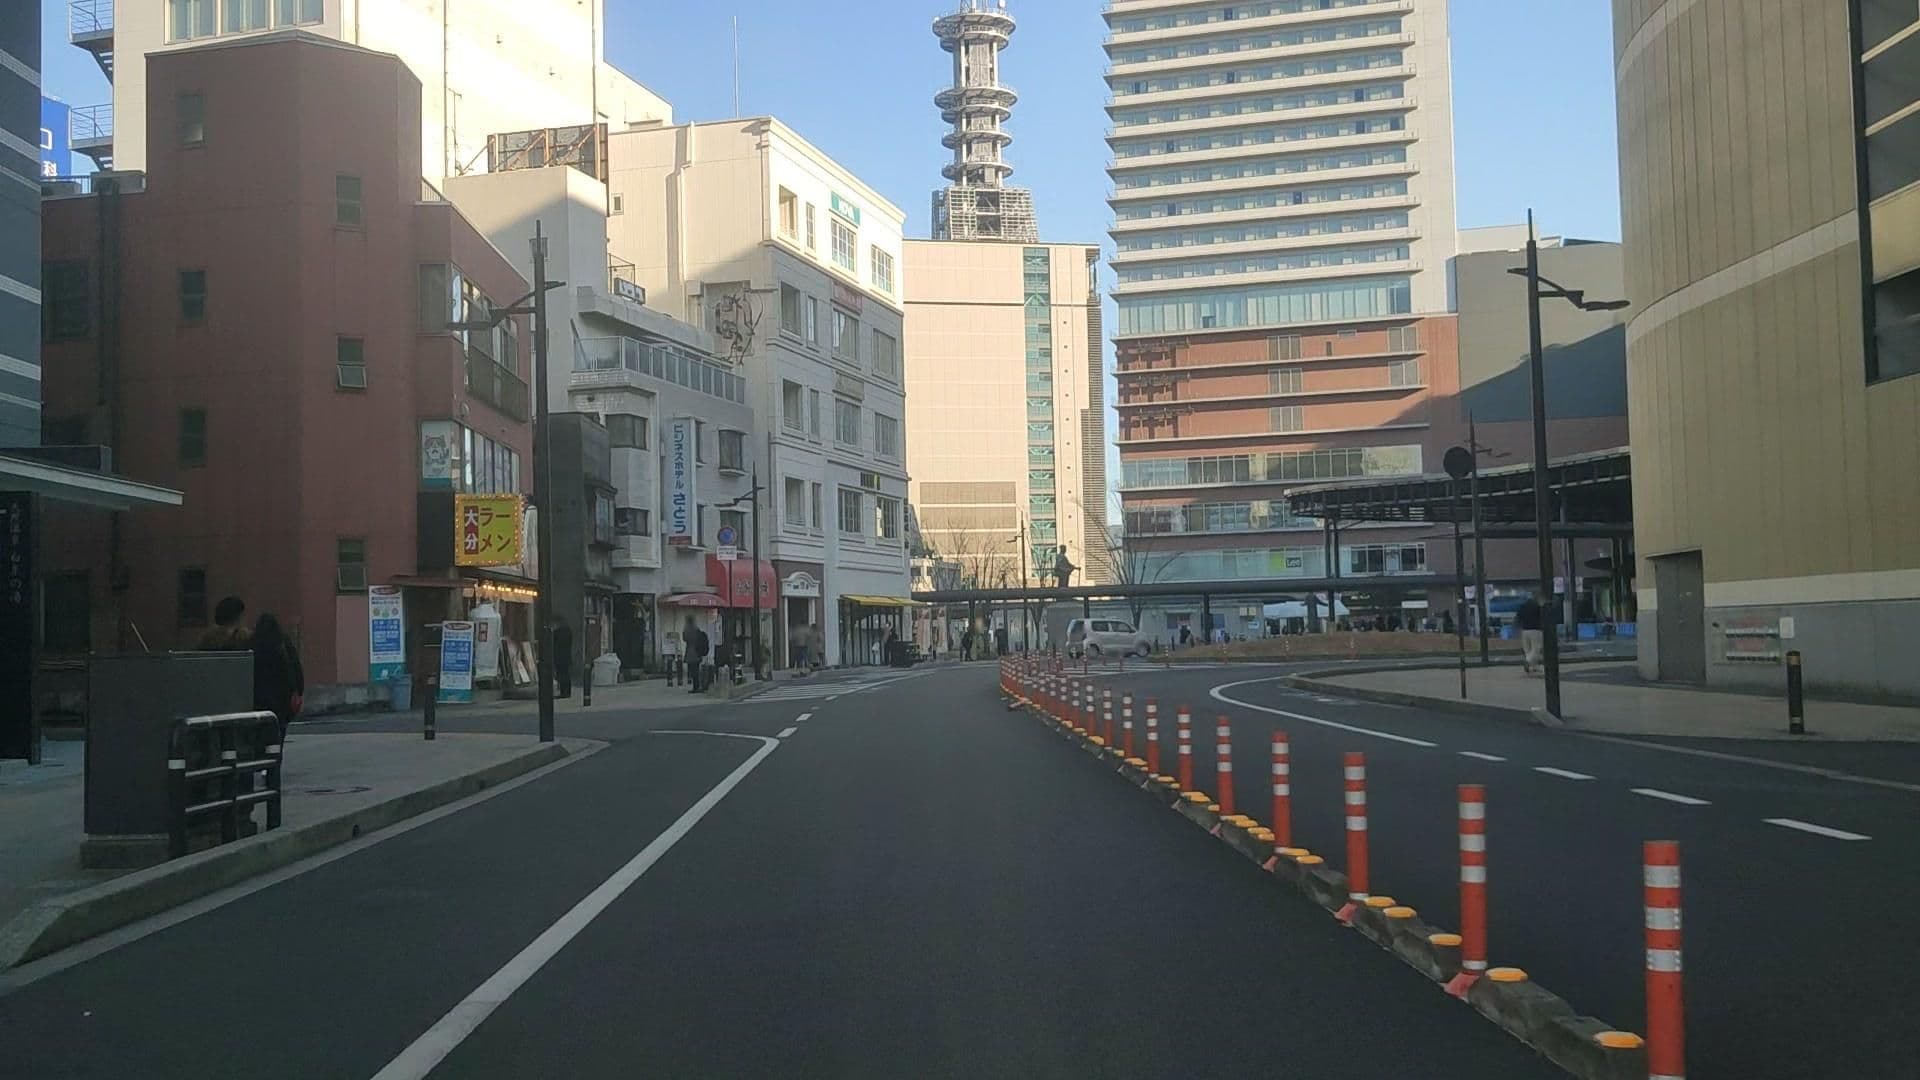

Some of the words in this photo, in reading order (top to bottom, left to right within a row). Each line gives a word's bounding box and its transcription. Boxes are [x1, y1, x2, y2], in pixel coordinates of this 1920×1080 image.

[673, 423, 685, 490] ビジネスホテル
[465, 509, 478, 550] 大分
[672, 492, 686, 534] さとう
